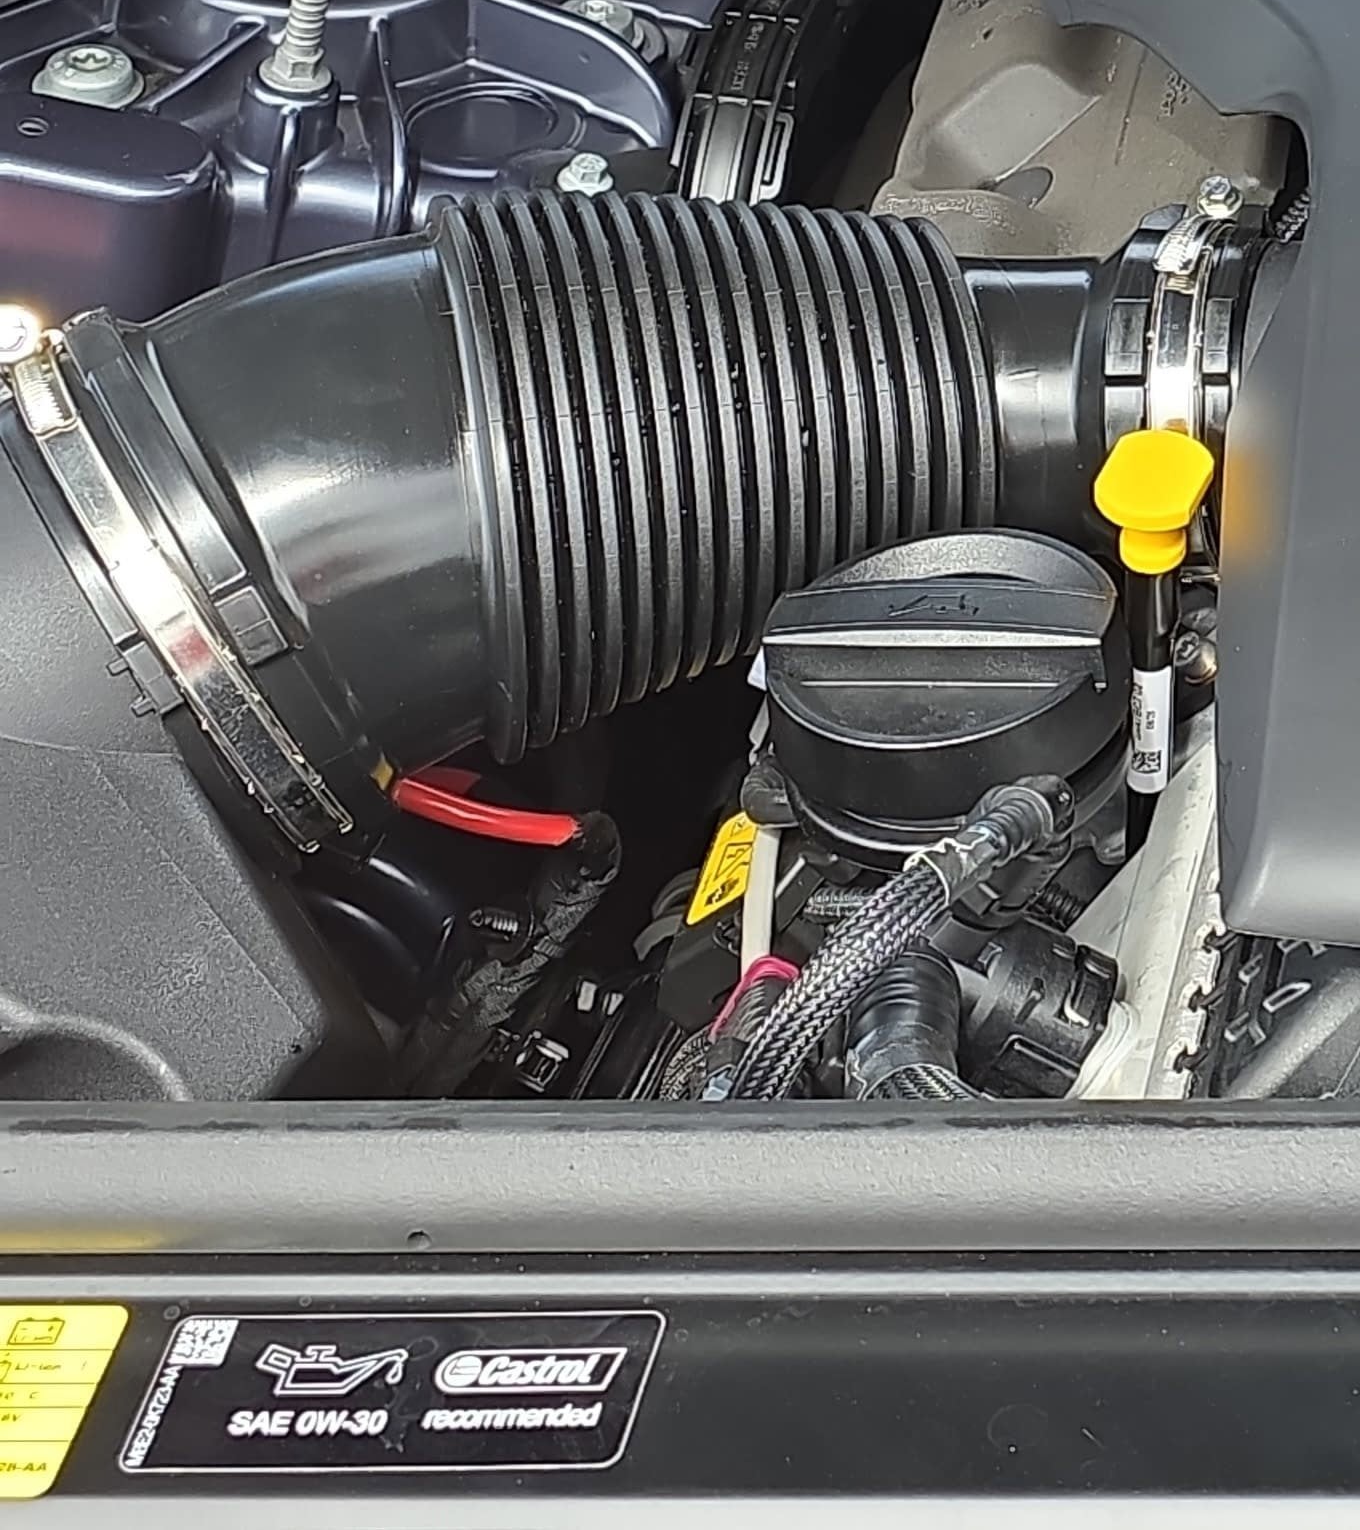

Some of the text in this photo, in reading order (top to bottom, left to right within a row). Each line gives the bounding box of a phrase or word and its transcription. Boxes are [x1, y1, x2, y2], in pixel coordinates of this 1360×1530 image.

[478, 1352, 602, 1385] Castrol
[227, 1409, 388, 1436] SAE 0W-30
[421, 1401, 603, 1429] recommended
